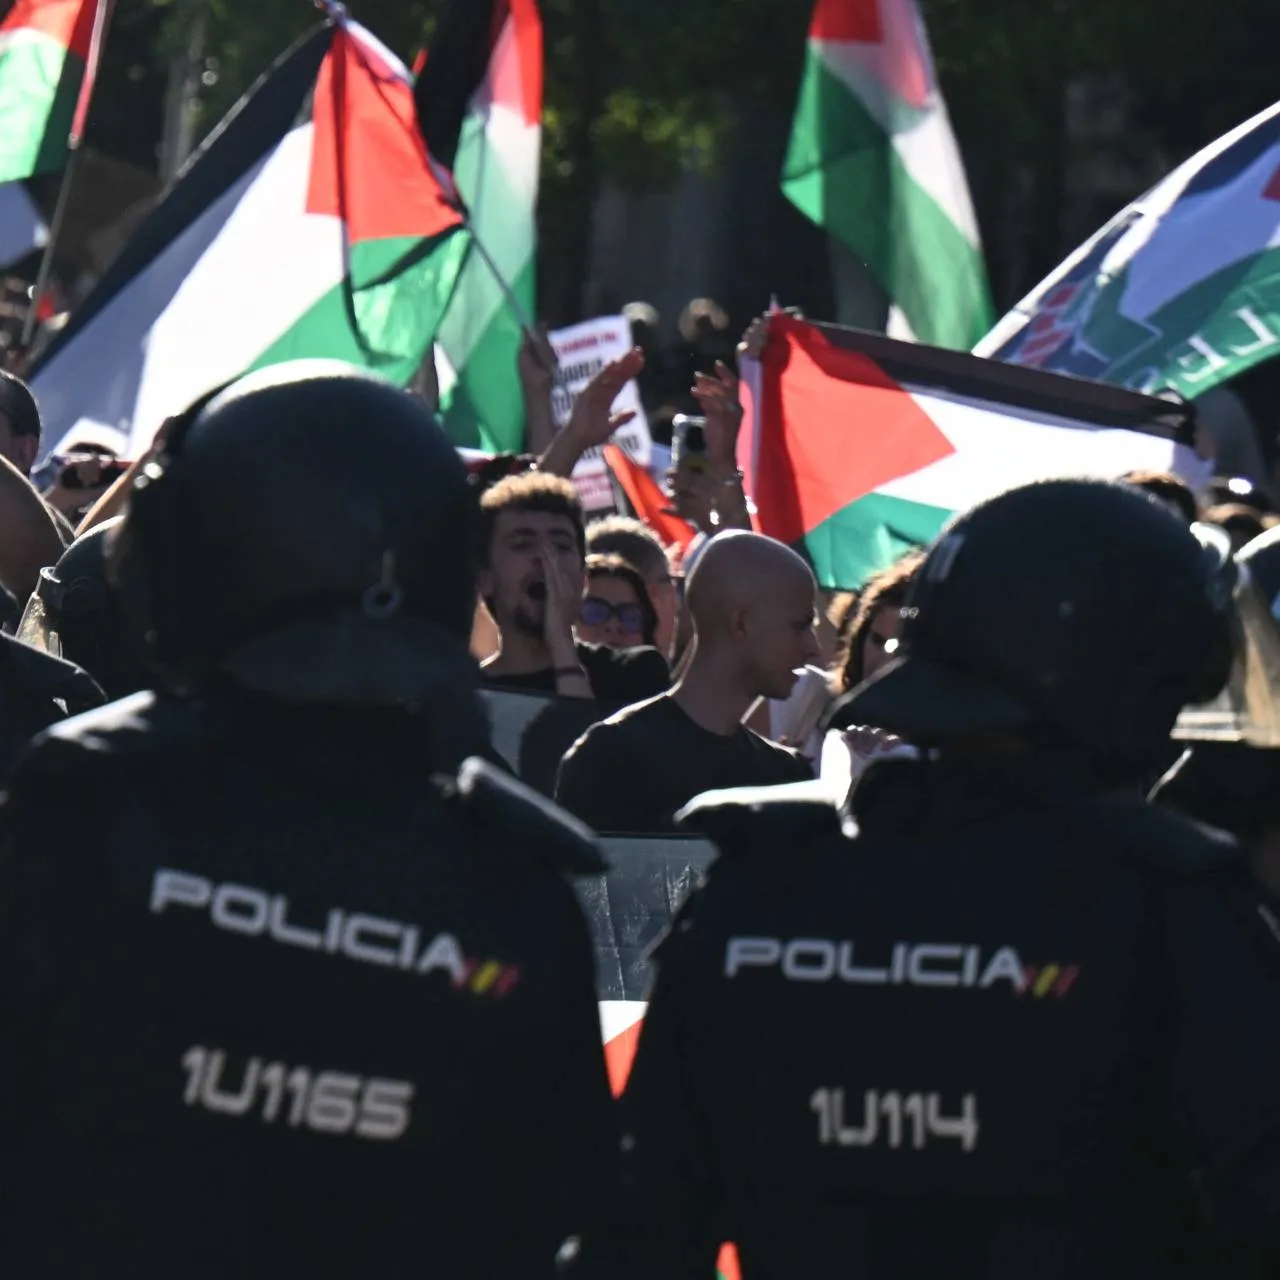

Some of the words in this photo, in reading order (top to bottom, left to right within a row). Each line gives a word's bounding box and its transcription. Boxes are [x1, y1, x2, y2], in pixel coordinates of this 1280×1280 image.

[150, 867, 467, 986] POLICIA
[724, 937, 1028, 991] POLICIA
[180, 1044, 415, 1140] 1U1165
[810, 1087, 979, 1152] 1U114
